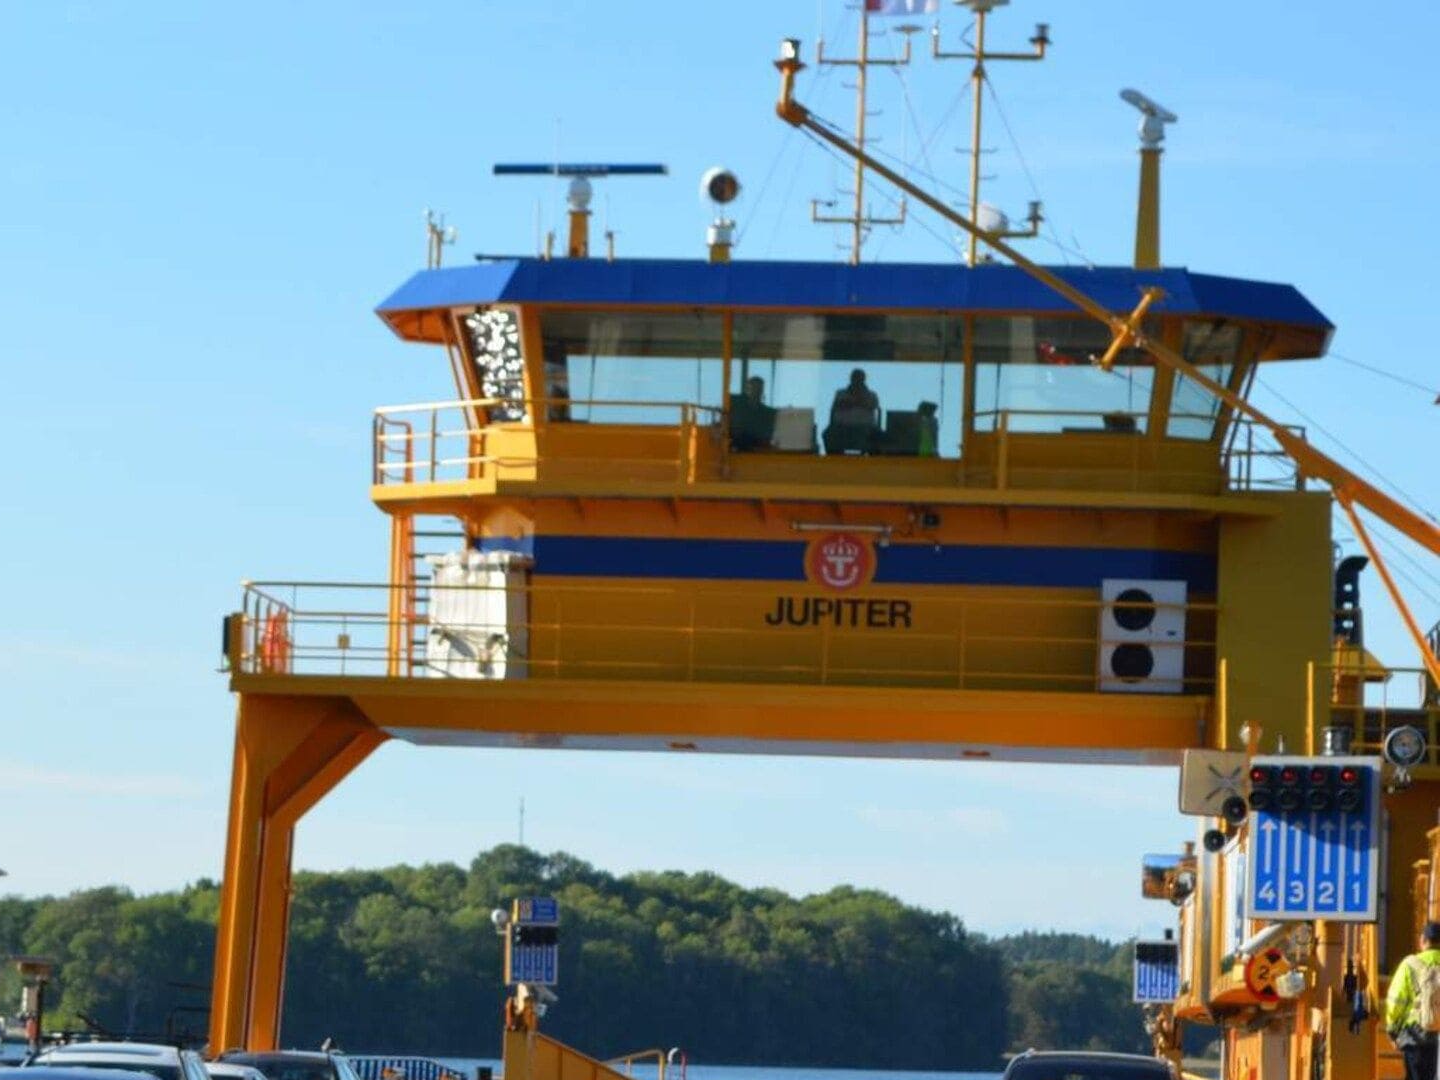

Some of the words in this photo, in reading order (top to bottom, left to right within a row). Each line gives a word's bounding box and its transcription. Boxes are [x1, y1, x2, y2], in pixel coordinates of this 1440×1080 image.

[765, 597, 912, 628] JUPITER
[1258, 880, 1276, 904] 4
[1289, 880, 1305, 904] 3
[1318, 881, 1334, 904] 2
[1352, 881, 1360, 905] 1
